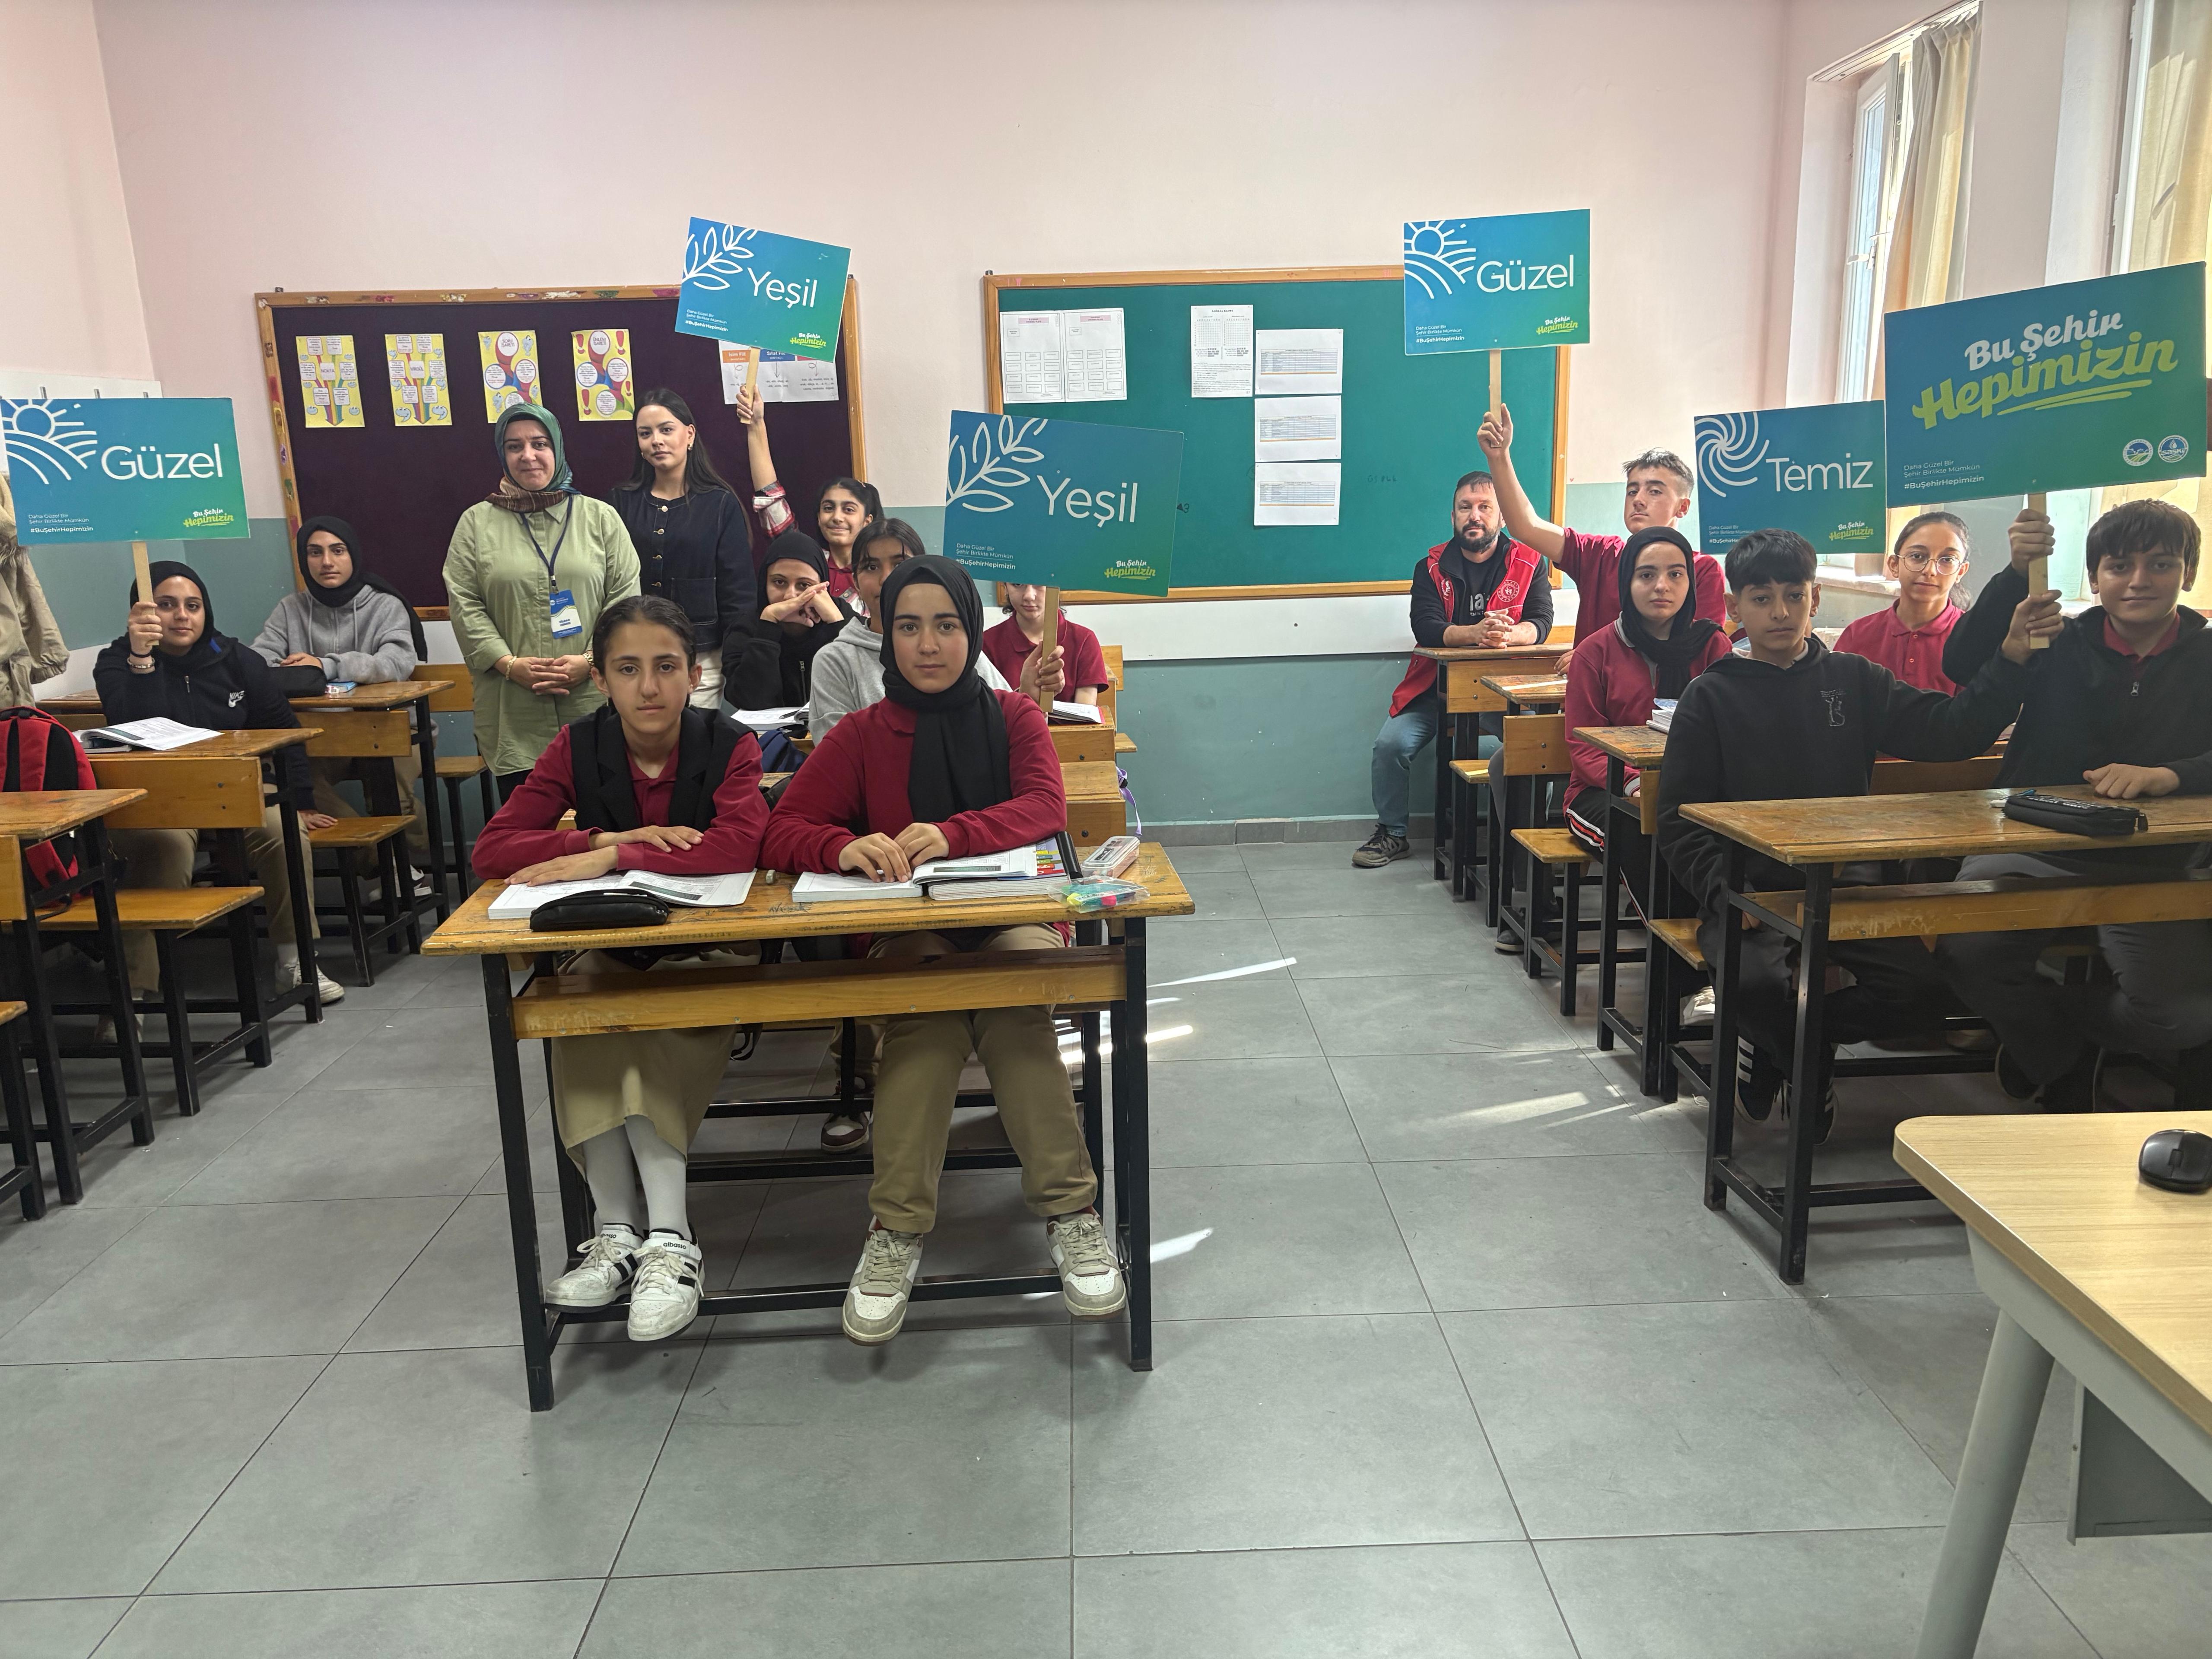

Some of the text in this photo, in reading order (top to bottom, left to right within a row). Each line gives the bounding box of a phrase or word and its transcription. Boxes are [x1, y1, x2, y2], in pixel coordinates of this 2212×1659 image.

[1477, 254, 1574, 292] Güzel
[747, 267, 818, 308] Yeşil
[685, 320, 728, 331] #BuŞehirHepimizin
[1536, 321, 1579, 335] Hepimizin
[790, 337, 826, 346] Hepimizin
[1964, 309, 2123, 371] Bu Şehir
[1912, 331, 2178, 429] Hepimizin
[101, 443, 223, 480] Güzel
[1766, 453, 1873, 492] Temiz
[1923, 467, 1947, 475] Birlikte
[1904, 475, 1984, 489] #BuŞehirHepimizin
[1037, 475, 1138, 528] Yeşil
[204, 508, 223, 516] Şehir
[183, 513, 234, 527] Hepimizin
[1829, 526, 1874, 541] Hepimizin
[1127, 559, 1147, 568] Şehir
[1104, 566, 1156, 578] Hepimizin
[230, 690, 245, 699] NIKE
